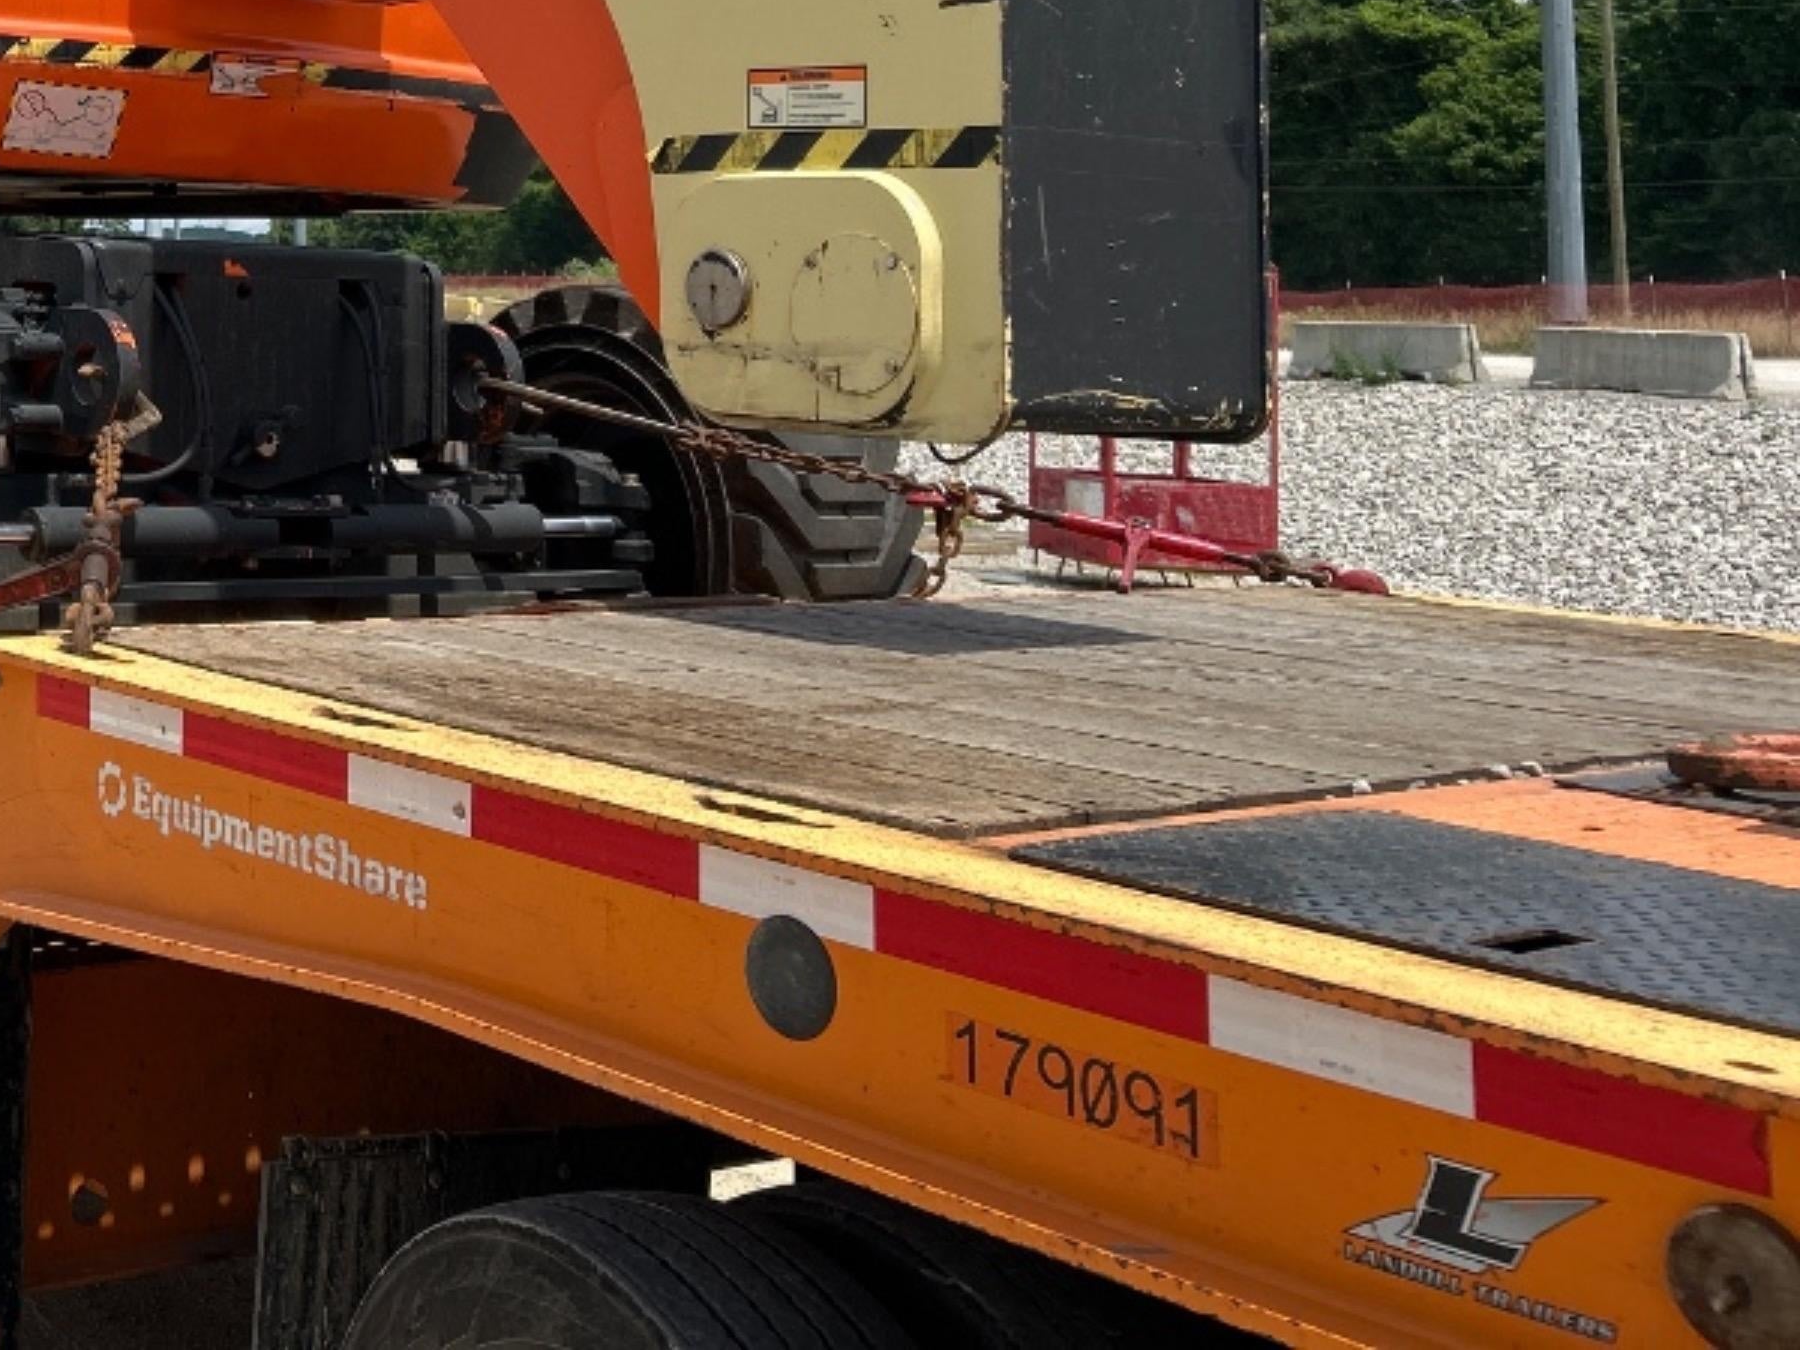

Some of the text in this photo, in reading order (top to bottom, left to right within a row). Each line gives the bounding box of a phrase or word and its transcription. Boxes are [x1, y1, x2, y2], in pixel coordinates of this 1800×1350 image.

[131, 774, 429, 910] EquipmentShare
[955, 1019, 1199, 1158] 179091
[1343, 1241, 1618, 1344] LANDOLL TRAILERS
